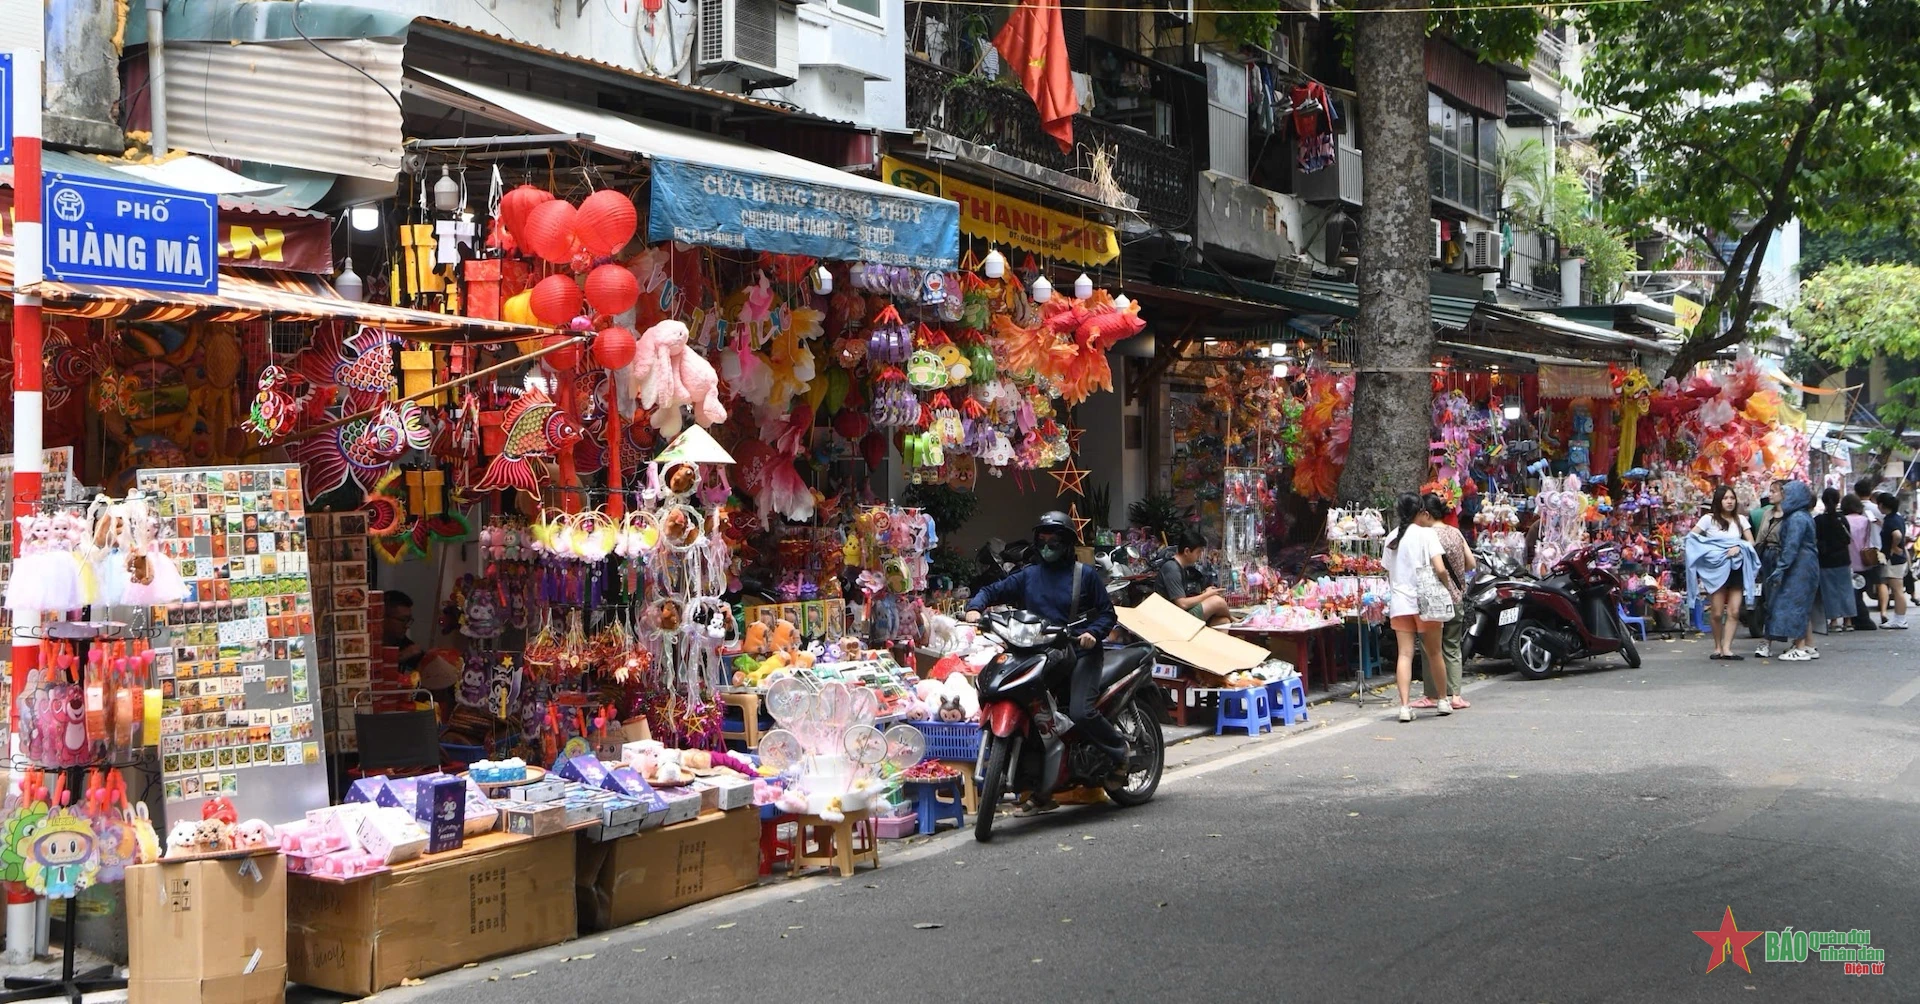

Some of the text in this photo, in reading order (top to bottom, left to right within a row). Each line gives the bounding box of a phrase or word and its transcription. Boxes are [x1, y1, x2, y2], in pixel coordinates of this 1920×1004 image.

[703, 170, 747, 200] CỬA
[116, 198, 171, 222] PHỐ
[741, 209, 785, 232] CHUYÊN
[803, 216, 831, 238] VÀNG
[57, 222, 147, 271] HÀNG
[156, 235, 204, 277] MÃ
